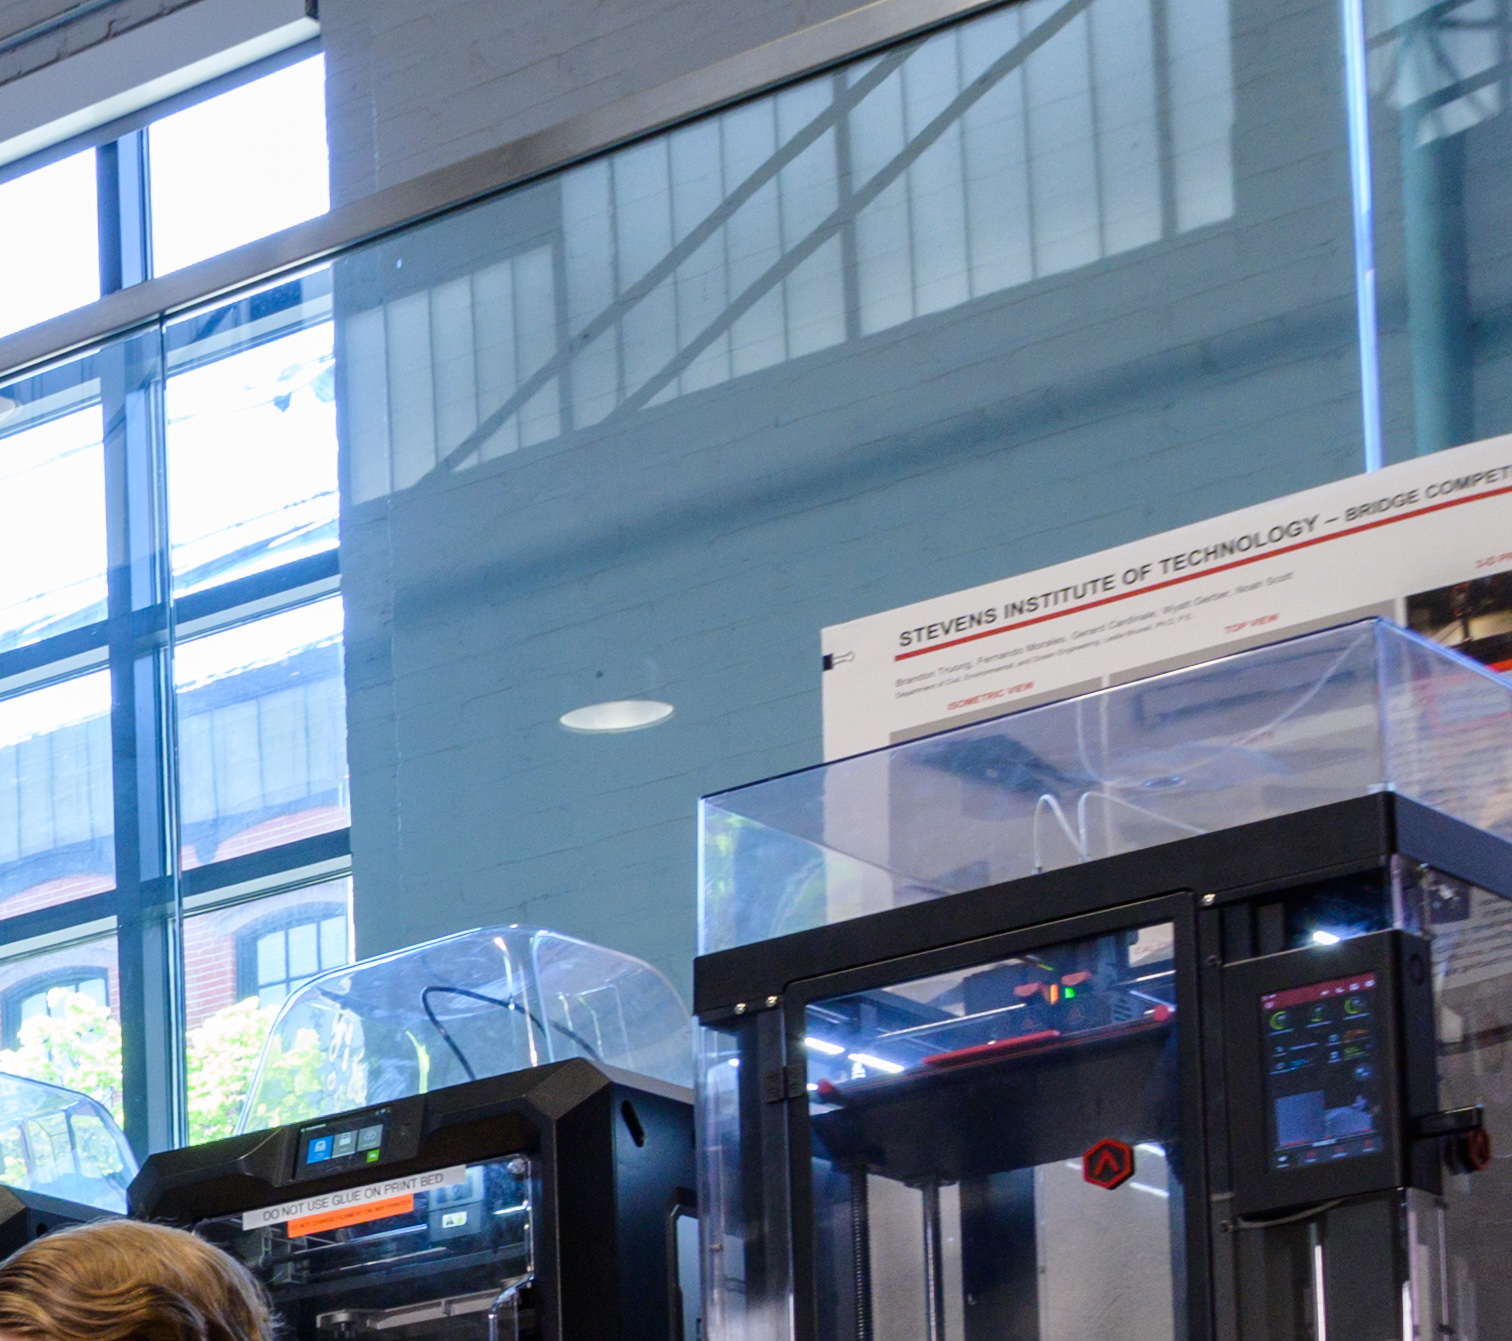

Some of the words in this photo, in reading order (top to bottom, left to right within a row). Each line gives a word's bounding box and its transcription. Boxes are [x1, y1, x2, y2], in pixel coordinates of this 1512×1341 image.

[900, 608, 996, 646] STEVENS
[1004, 574, 1114, 617] INSTITUTE
[1122, 563, 1151, 585] OF
[1161, 516, 1316, 572] TECHNOLOGY
[1345, 490, 1418, 521] BRIDGE
[1425, 465, 1512, 498] COMPET
[262, 1208, 279, 1221] DO
[281, 1202, 304, 1215] NOT
[307, 1197, 328, 1211] USE
[332, 1189, 360, 1205] GLUE
[364, 1185, 381, 1198] ON
[384, 1177, 417, 1193] PRINT
[420, 1172, 444, 1186] BED
